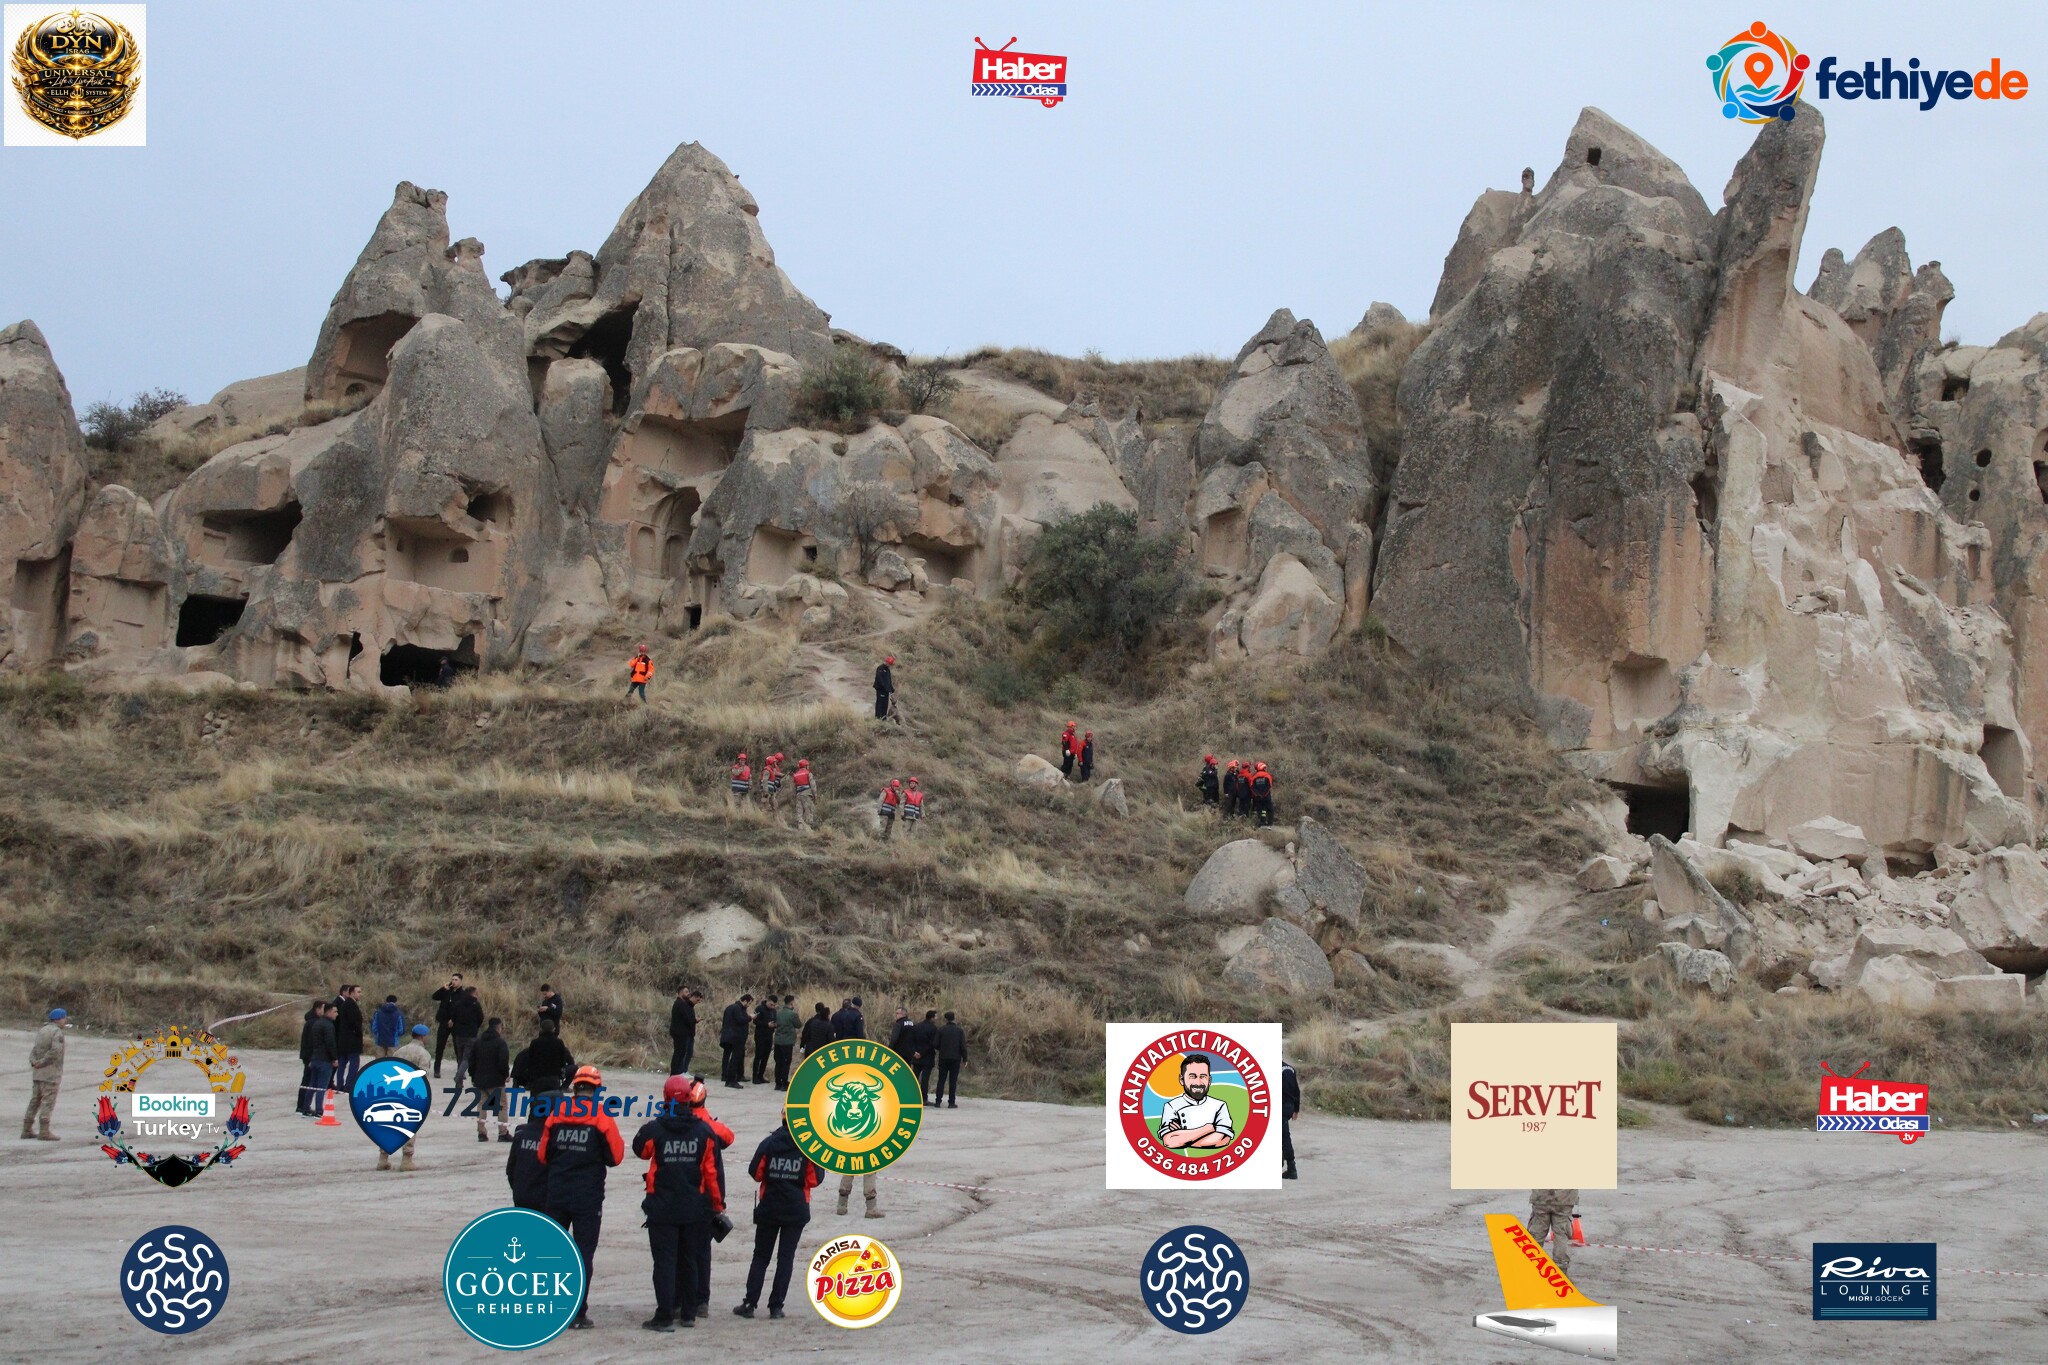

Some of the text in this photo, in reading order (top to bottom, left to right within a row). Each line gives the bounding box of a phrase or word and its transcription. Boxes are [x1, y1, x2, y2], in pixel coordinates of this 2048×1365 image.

[556, 1129, 589, 1143] AFAD
[663, 1140, 698, 1154] AFAD
[769, 1157, 802, 1172] AFAD
